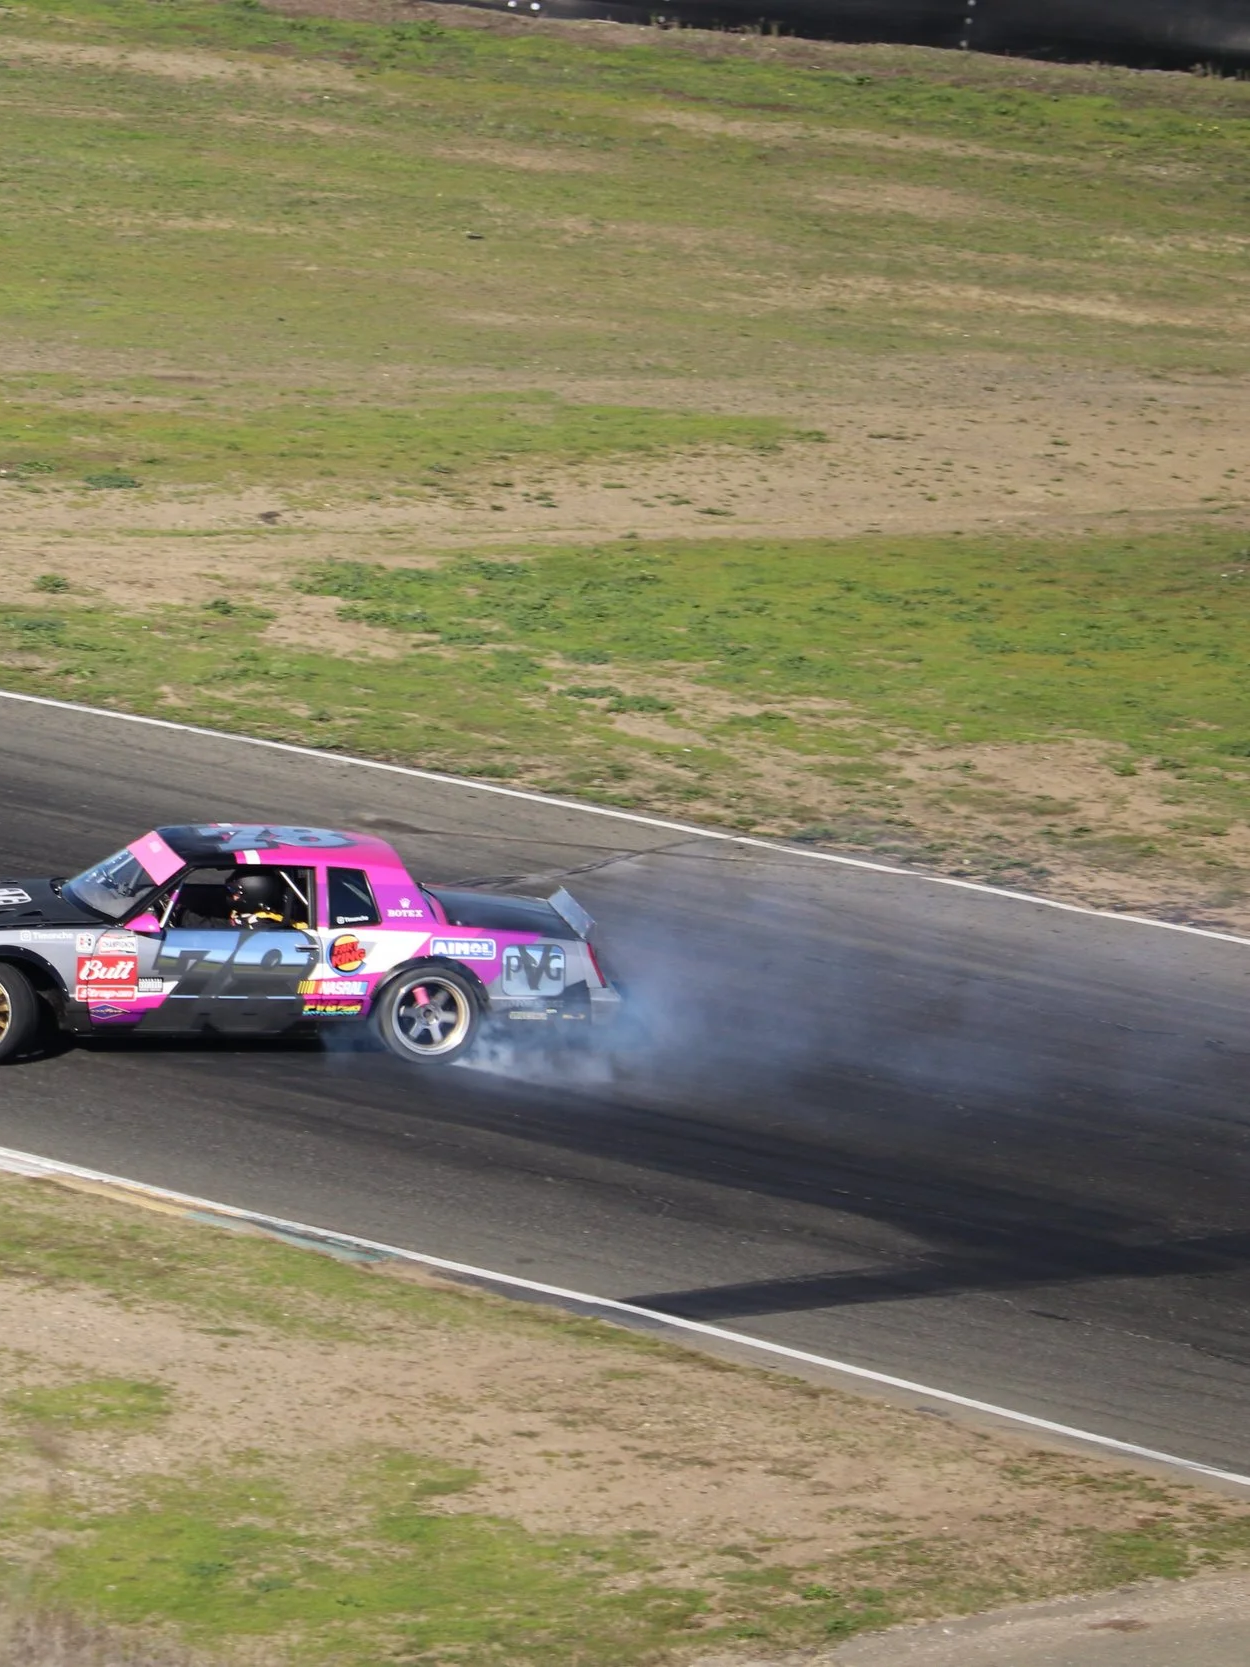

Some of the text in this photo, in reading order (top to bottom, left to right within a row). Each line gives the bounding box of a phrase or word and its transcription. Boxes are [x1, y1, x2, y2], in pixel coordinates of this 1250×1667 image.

[387, 909, 423, 918] BOTEX
[331, 948, 366, 968] KING
[506, 945, 562, 990] PVG
[79, 959, 135, 980] Butt
